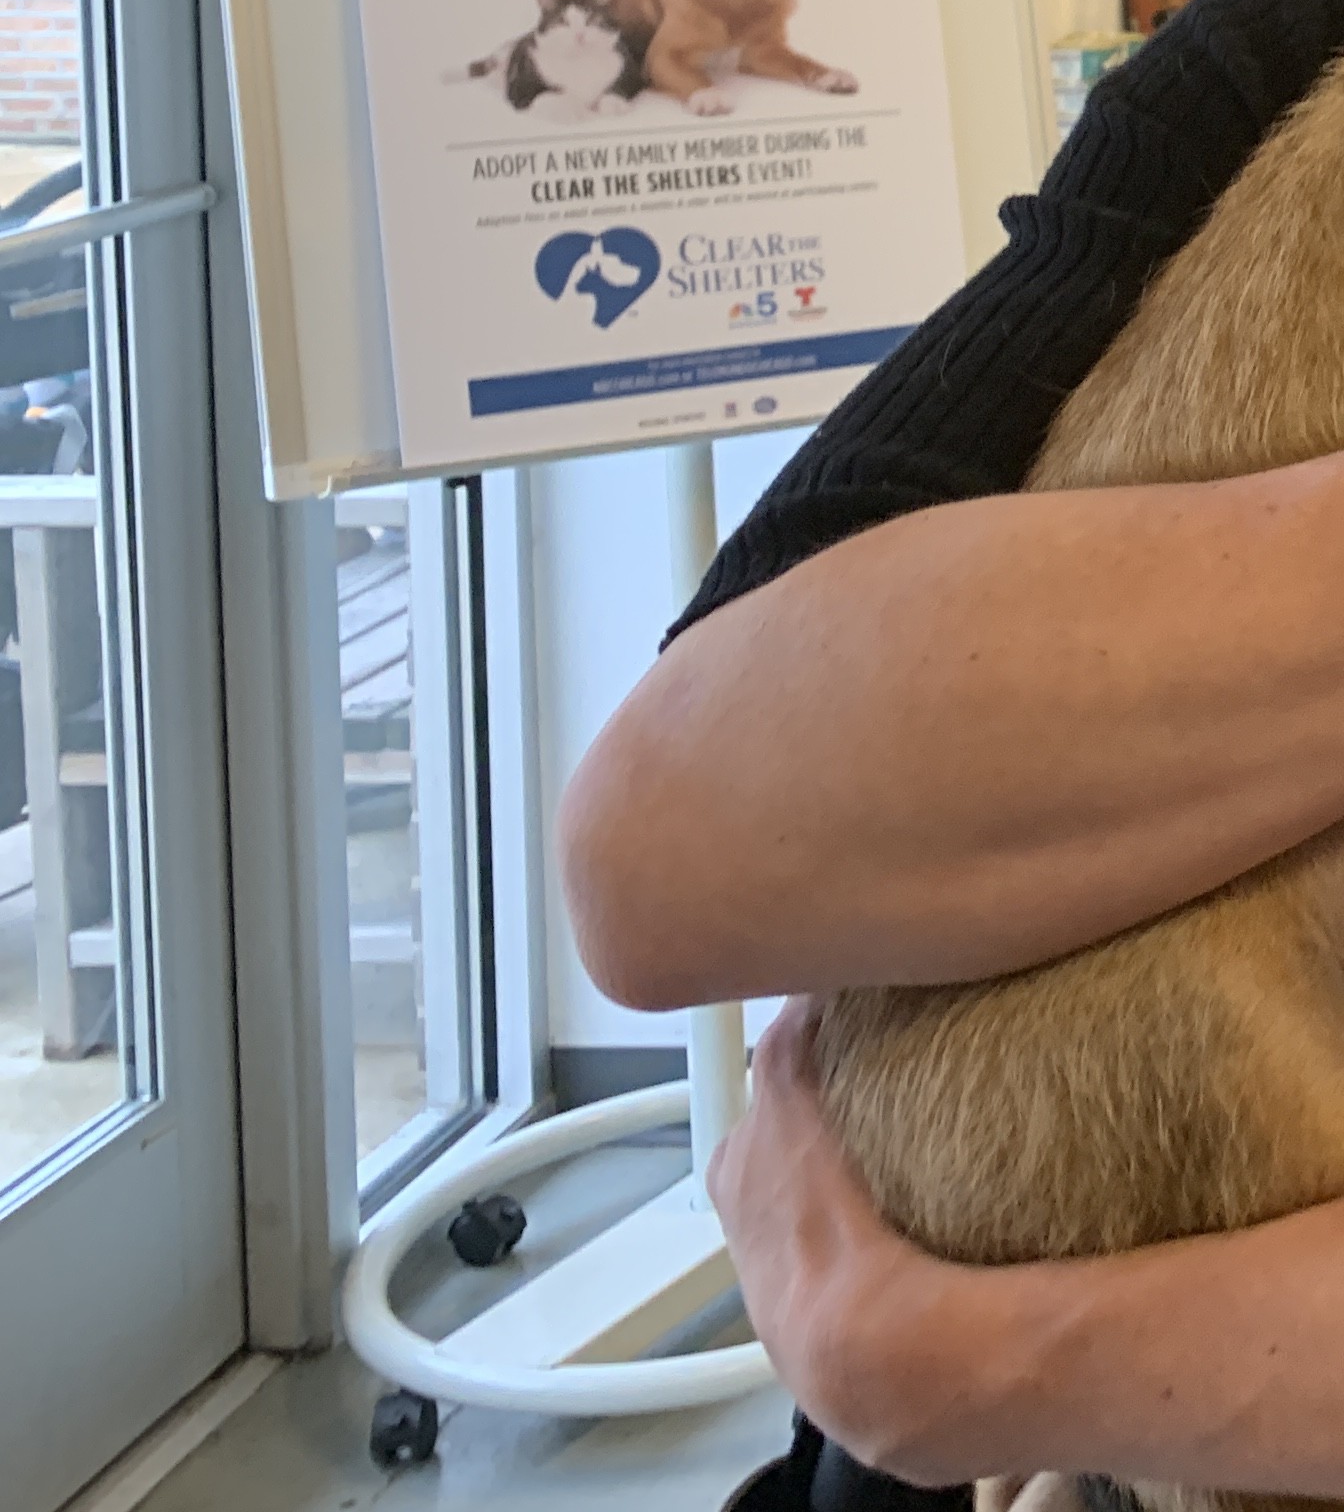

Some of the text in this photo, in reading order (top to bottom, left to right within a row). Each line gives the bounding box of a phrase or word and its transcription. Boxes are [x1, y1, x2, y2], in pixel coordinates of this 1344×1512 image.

[473, 124, 867, 180] ADOPT A NEW FAMILY MEMBER DURING THE
[531, 177, 595, 204] CLEAR
[604, 172, 640, 197] THE
[647, 163, 741, 193] SHELTERS
[678, 232, 785, 266] CLEAR
[667, 257, 826, 299] SHELTERS
[757, 291, 778, 318] 5
